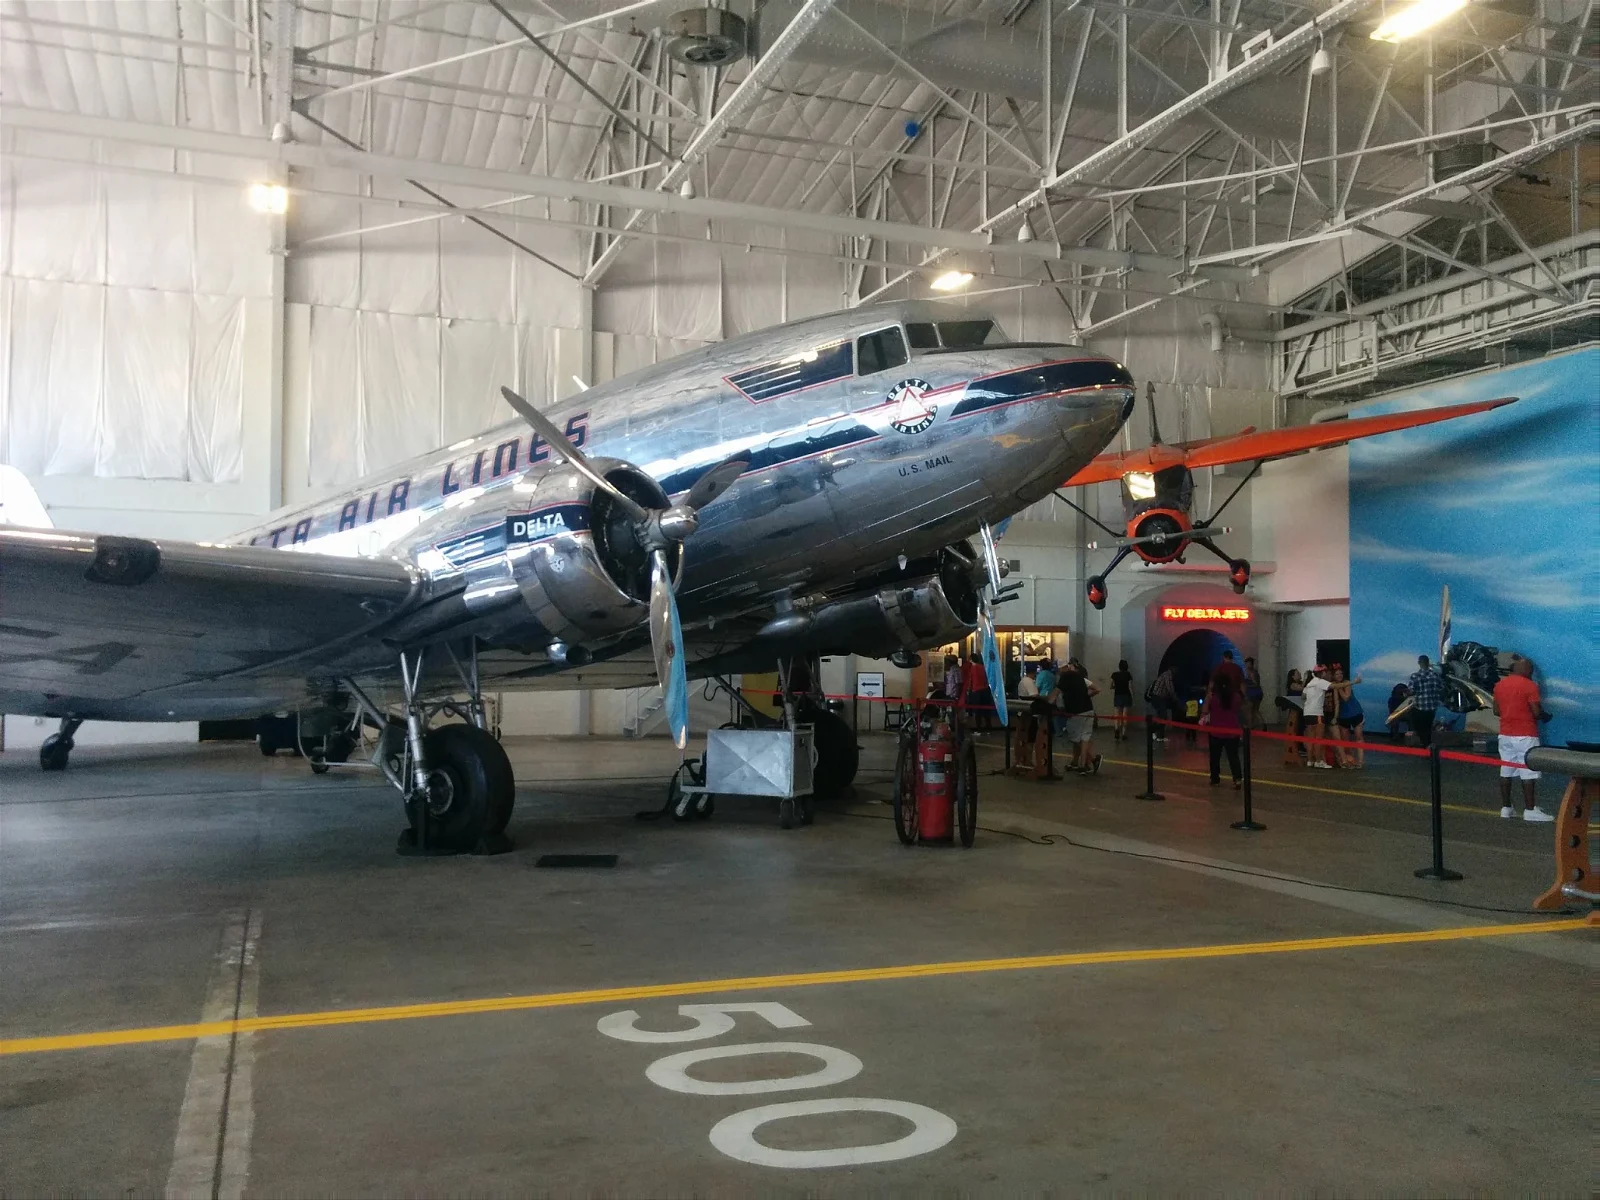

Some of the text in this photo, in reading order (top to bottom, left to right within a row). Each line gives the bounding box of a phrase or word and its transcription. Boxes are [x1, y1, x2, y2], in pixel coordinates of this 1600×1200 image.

[888, 379, 928, 400] DELTA
[898, 455, 953, 477] U.S. MAIL
[339, 479, 411, 532] AIR
[513, 512, 565, 537] DELTA
[1164, 608, 1249, 619] FLY DELTA JETS
[597, 1002, 957, 1169] 500
